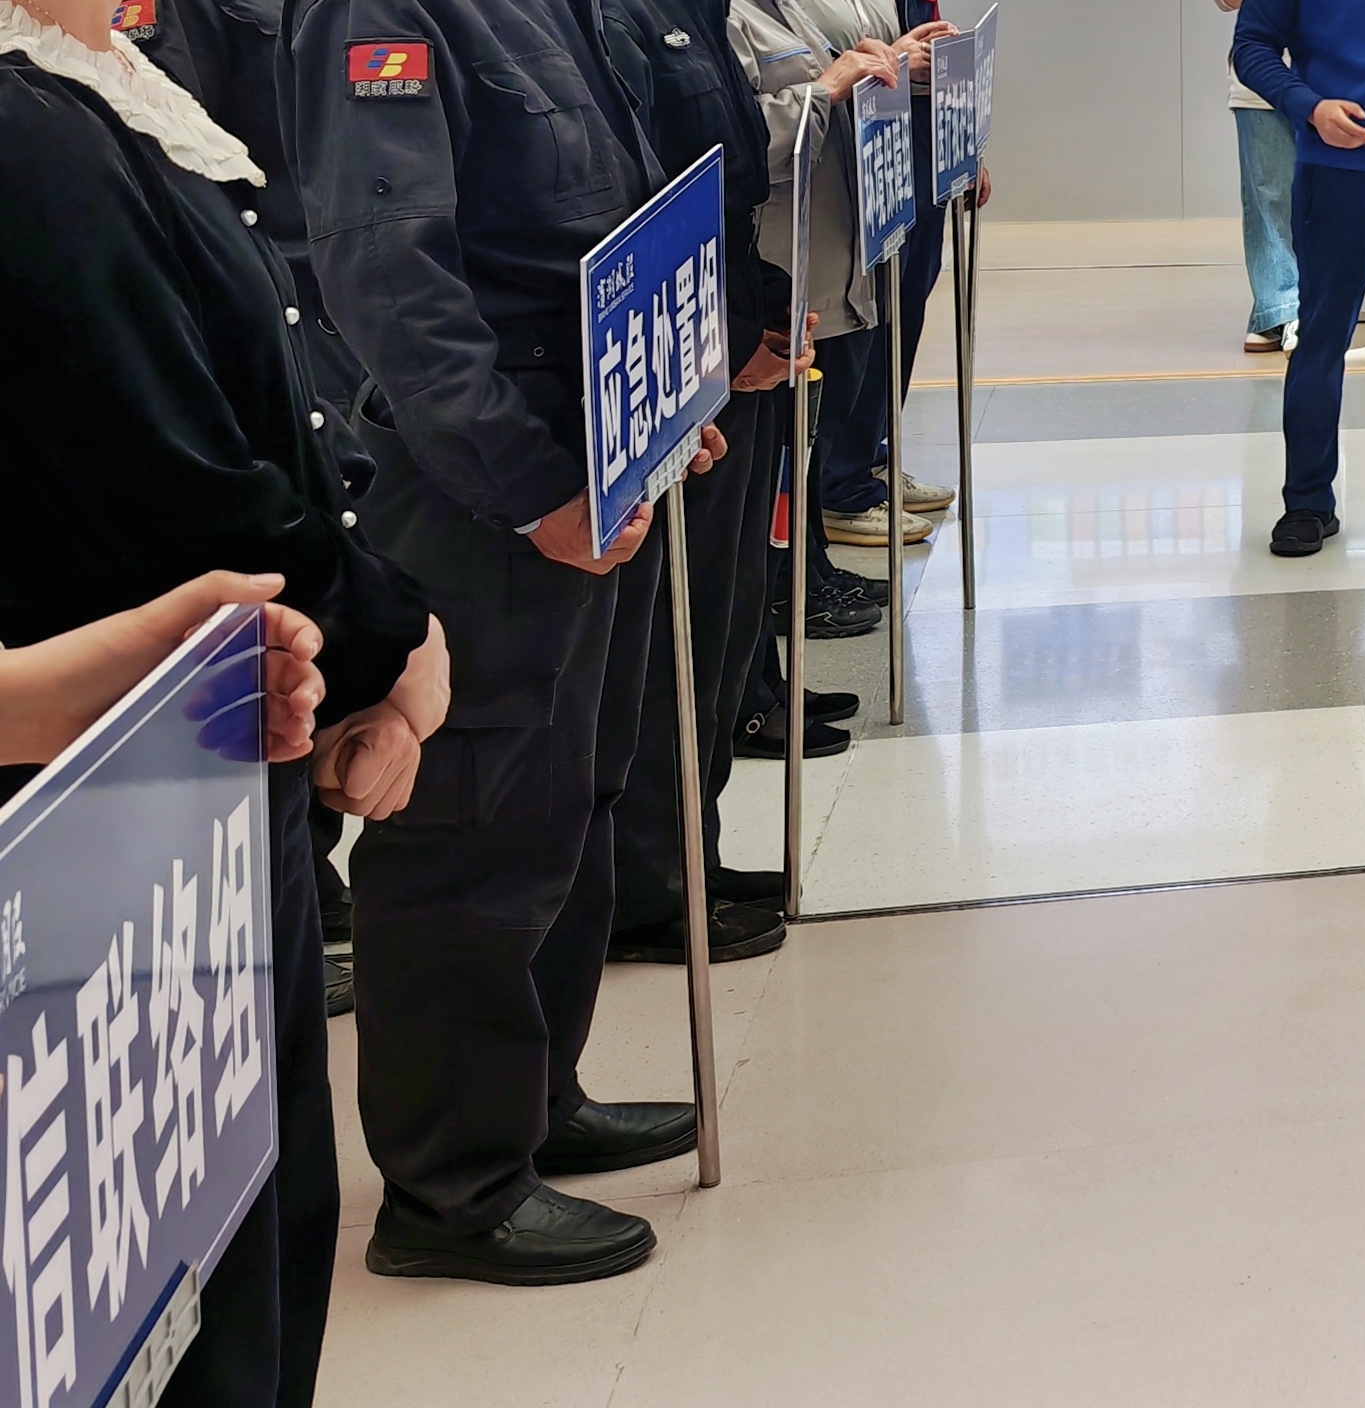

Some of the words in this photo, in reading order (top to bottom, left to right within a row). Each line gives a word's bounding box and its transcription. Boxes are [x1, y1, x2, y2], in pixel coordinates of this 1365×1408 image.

[863, 111, 912, 238] 环境保障组
[599, 238, 722, 497] 应急处置组
[0, 795, 262, 1408] 信联络组
